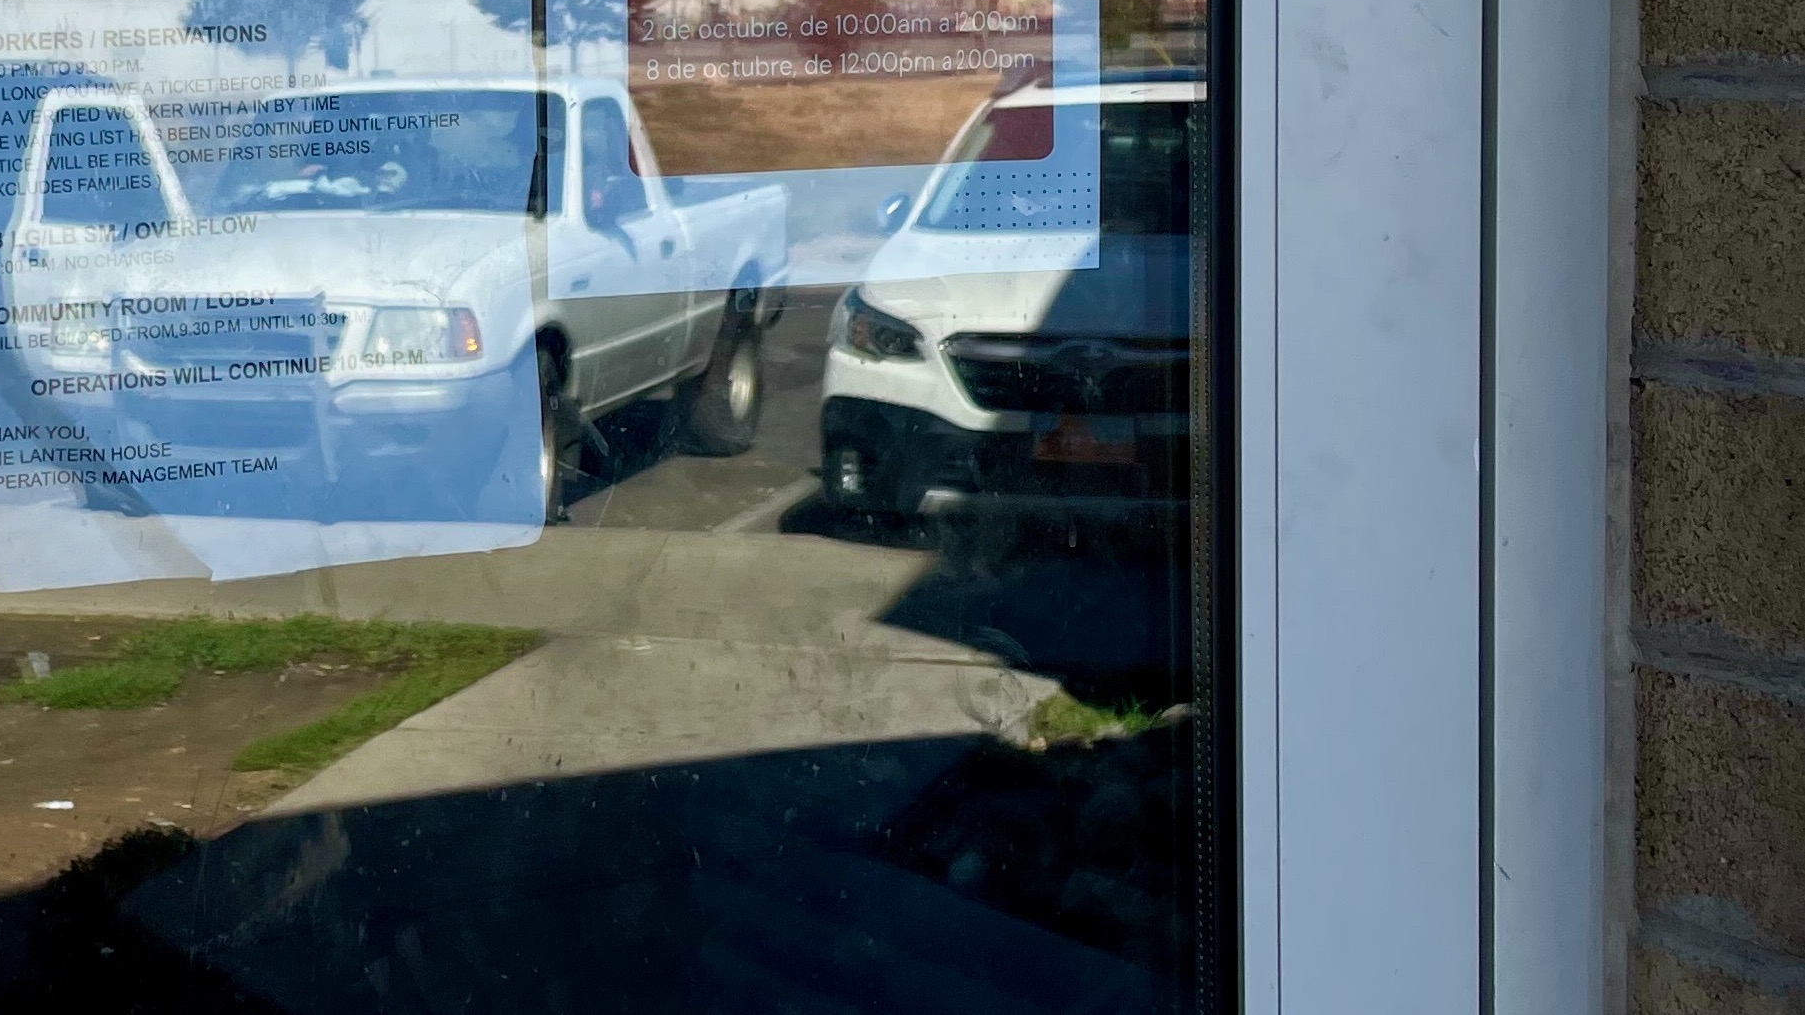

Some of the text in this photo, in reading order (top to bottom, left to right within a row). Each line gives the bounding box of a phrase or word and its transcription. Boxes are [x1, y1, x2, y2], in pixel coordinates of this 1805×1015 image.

[103, 24, 267, 48] RESERVATIONS
[642, 20, 655, 41] 2
[663, 19, 691, 40] de
[699, 18, 792, 40] octubre,
[800, 15, 828, 36] de
[835, 13, 931, 35] 10:00am
[48, 61, 70, 76] TO
[646, 59, 659, 81] 8
[668, 58, 695, 79] de
[703, 57, 796, 79] octubre,
[805, 55, 832, 75] de
[839, 51, 934, 76] 12:00pm
[2, 85, 48, 101] LONG
[143, 82, 154, 95] A
[159, 78, 215, 95] TICKET
[219, 75, 283, 92] BEFORE
[288, 75, 296, 88] 9
[1, 111, 14, 126] A
[189, 100, 231, 116] WITH
[236, 101, 249, 115] A
[253, 99, 268, 113] IN
[274, 97, 295, 113] BY
[300, 96, 340, 111] TIME
[89, 129, 124, 146] LIST
[130, 127, 163, 143] HS
[168, 126, 211, 141] BEEN
[216, 119, 334, 139] DISCONTINUED
[338, 116, 383, 133] UNTIL
[387, 113, 460, 130] FURTHER
[45, 156, 83, 172] WILL
[88, 154, 110, 168] BE
[114, 152, 154, 167] FIRS
[166, 148, 214, 164] COME
[218, 145, 263, 161] FIRST
[269, 142, 321, 158] SERVE
[78, 174, 152, 192] FAMILIES
[135, 216, 258, 239] OVERFLOW
[65, 254, 89, 270] NO
[94, 250, 175, 268] CHANGES
[121, 296, 187, 316] ROOM
[206, 289, 277, 309] LOBBY
[28, 334, 50, 348] BE
[249, 315, 294, 331] UNTIL
[31, 369, 167, 396] OPERATIONS
[172, 366, 222, 385] WILL
[46, 425, 90, 442] YOU,
[20, 447, 105, 465] LANTERN
[111, 441, 172, 461] HOUSE
[102, 460, 226, 485] MANAGEMENT
[231, 456, 278, 473] TEAM
